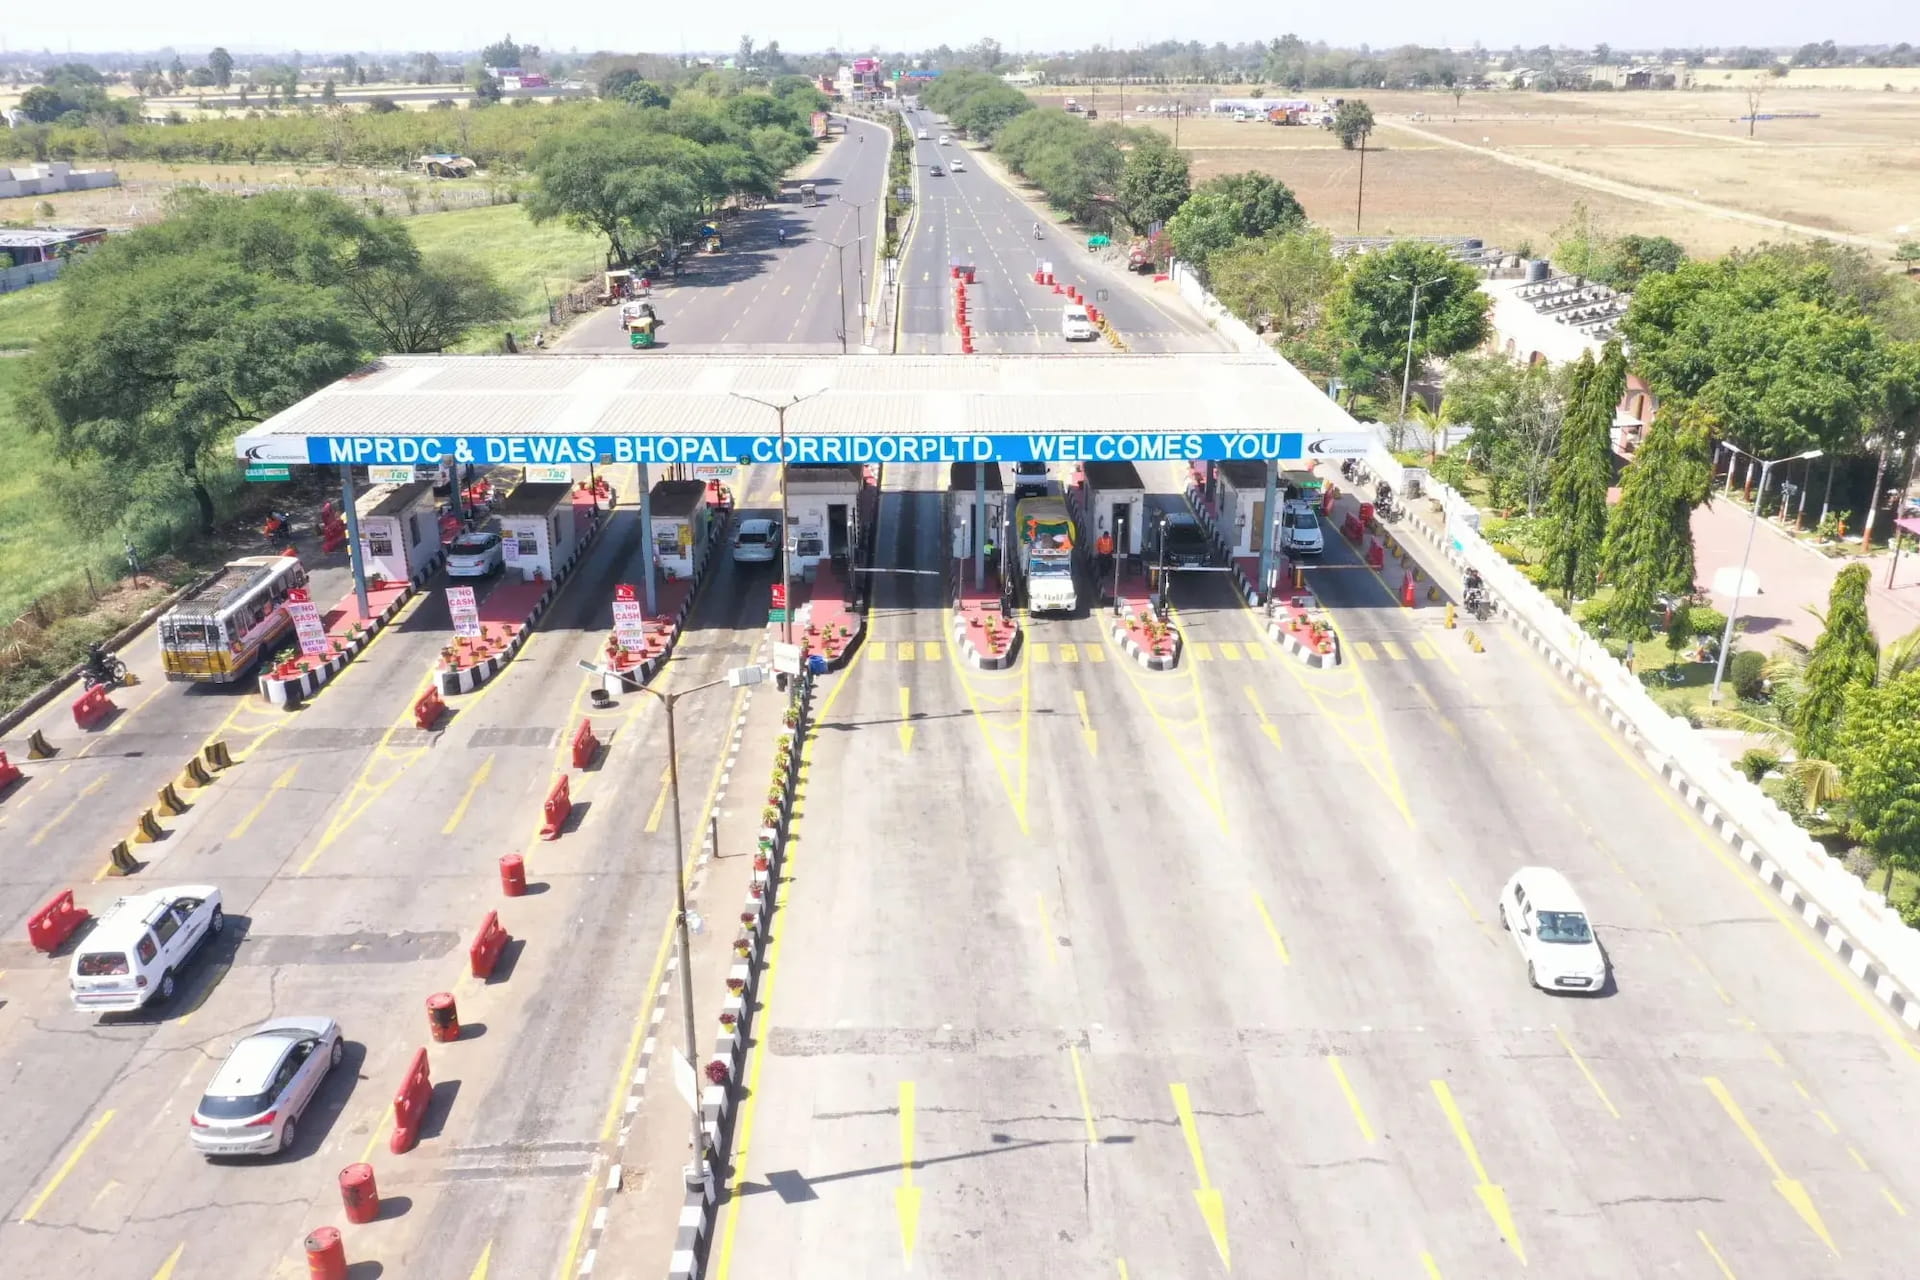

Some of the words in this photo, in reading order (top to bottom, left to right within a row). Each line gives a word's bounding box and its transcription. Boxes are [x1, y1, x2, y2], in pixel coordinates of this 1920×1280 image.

[328, 438, 442, 462] MPRDC
[455, 438, 475, 462] &
[485, 438, 597, 462] DEWAS
[614, 437, 738, 462] BHOPAL
[1028, 435, 1202, 460] WELCOMES
[1219, 434, 1281, 459] YOU
[294, 614, 319, 622] CASH
